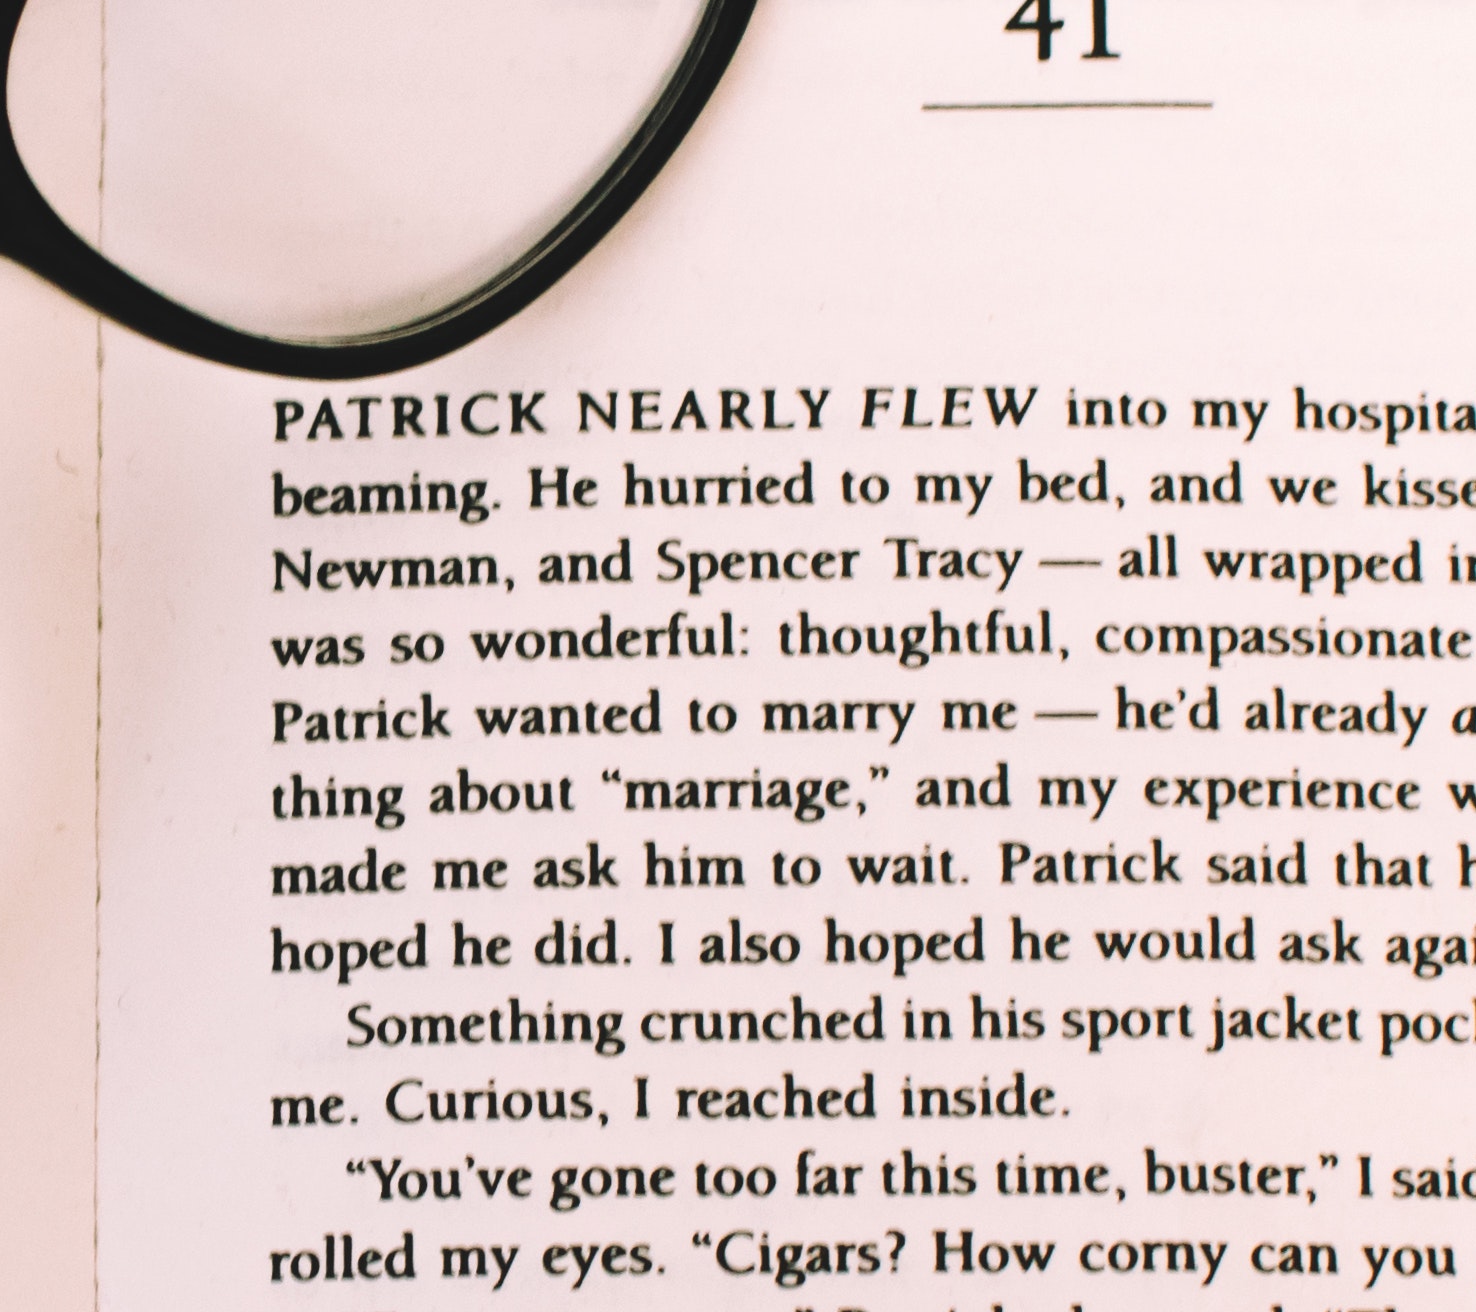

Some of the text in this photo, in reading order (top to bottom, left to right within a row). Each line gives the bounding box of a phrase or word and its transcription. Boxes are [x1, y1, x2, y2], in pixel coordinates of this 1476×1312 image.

[274, 391, 546, 442] PATRICK
[577, 388, 831, 433] NEARLY
[861, 386, 1038, 429] FLEW
[1067, 388, 1167, 428] into
[1192, 399, 1269, 443] my
[270, 634, 365, 668] was
[390, 632, 444, 664] so
[470, 610, 748, 661] wonderful:
[779, 608, 1069, 669] thoughtful,
[347, 997, 626, 1058] Something
[641, 994, 886, 1043] crunched
[903, 998, 953, 1041] in
[970, 993, 1045, 1040] his
[1062, 1004, 1194, 1054] sport
[1206, 993, 1362, 1054] jacket
[271, 1071, 1070, 1128] me. Curious, I reached inside.
